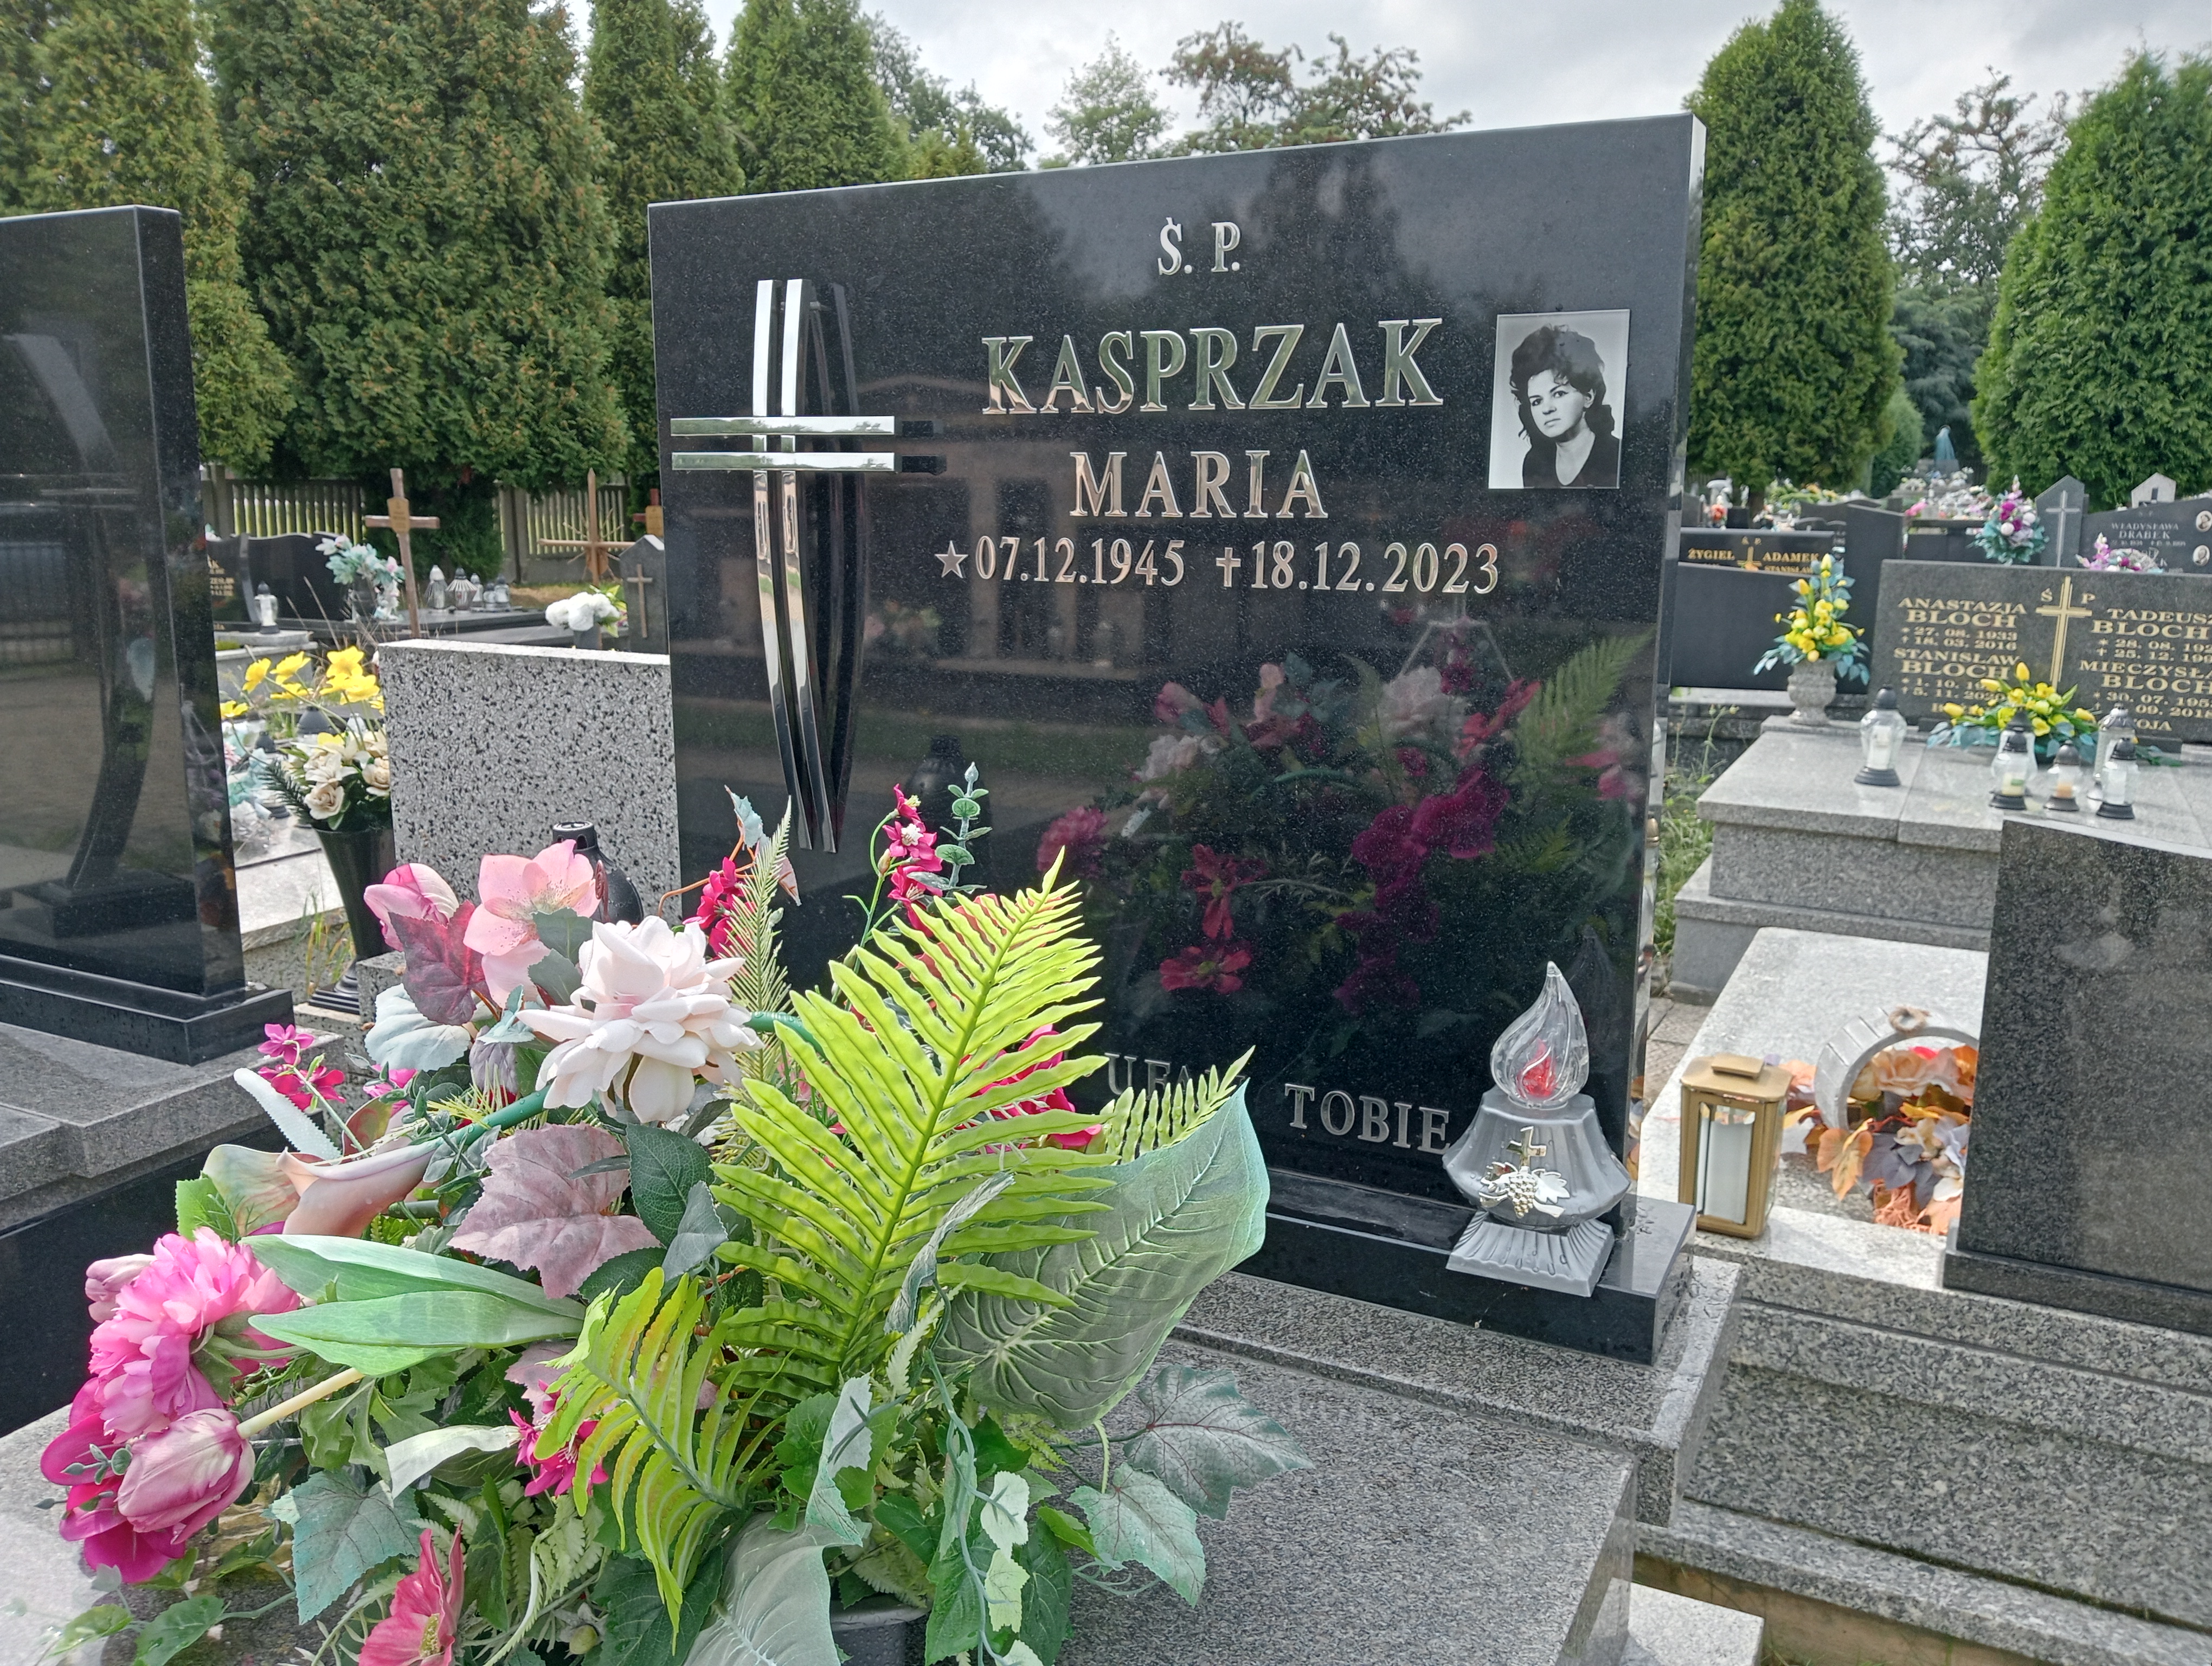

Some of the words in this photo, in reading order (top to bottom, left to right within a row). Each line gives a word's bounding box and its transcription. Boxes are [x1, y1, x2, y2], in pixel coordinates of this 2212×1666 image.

[1211, 221, 1242, 272] P.
[982, 318, 1444, 415] KASPRZAK
[1070, 449, 1328, 518] MARIA
[976, 535, 1185, 587] 07.12.1945
[1251, 541, 1499, 594] 18.12.2023
[1763, 552, 1819, 563] ADAMEK
[1898, 597, 2027, 614] ANASTAZJA
[2081, 593, 2096, 604] P
[1906, 609, 2017, 628] BLOCH
[2091, 619, 2210, 640] BLOCH
[1901, 659, 2011, 680] BLOCH
[2101, 674, 2212, 695] BLOCH
[1285, 1082, 1451, 1155] TOBIE
